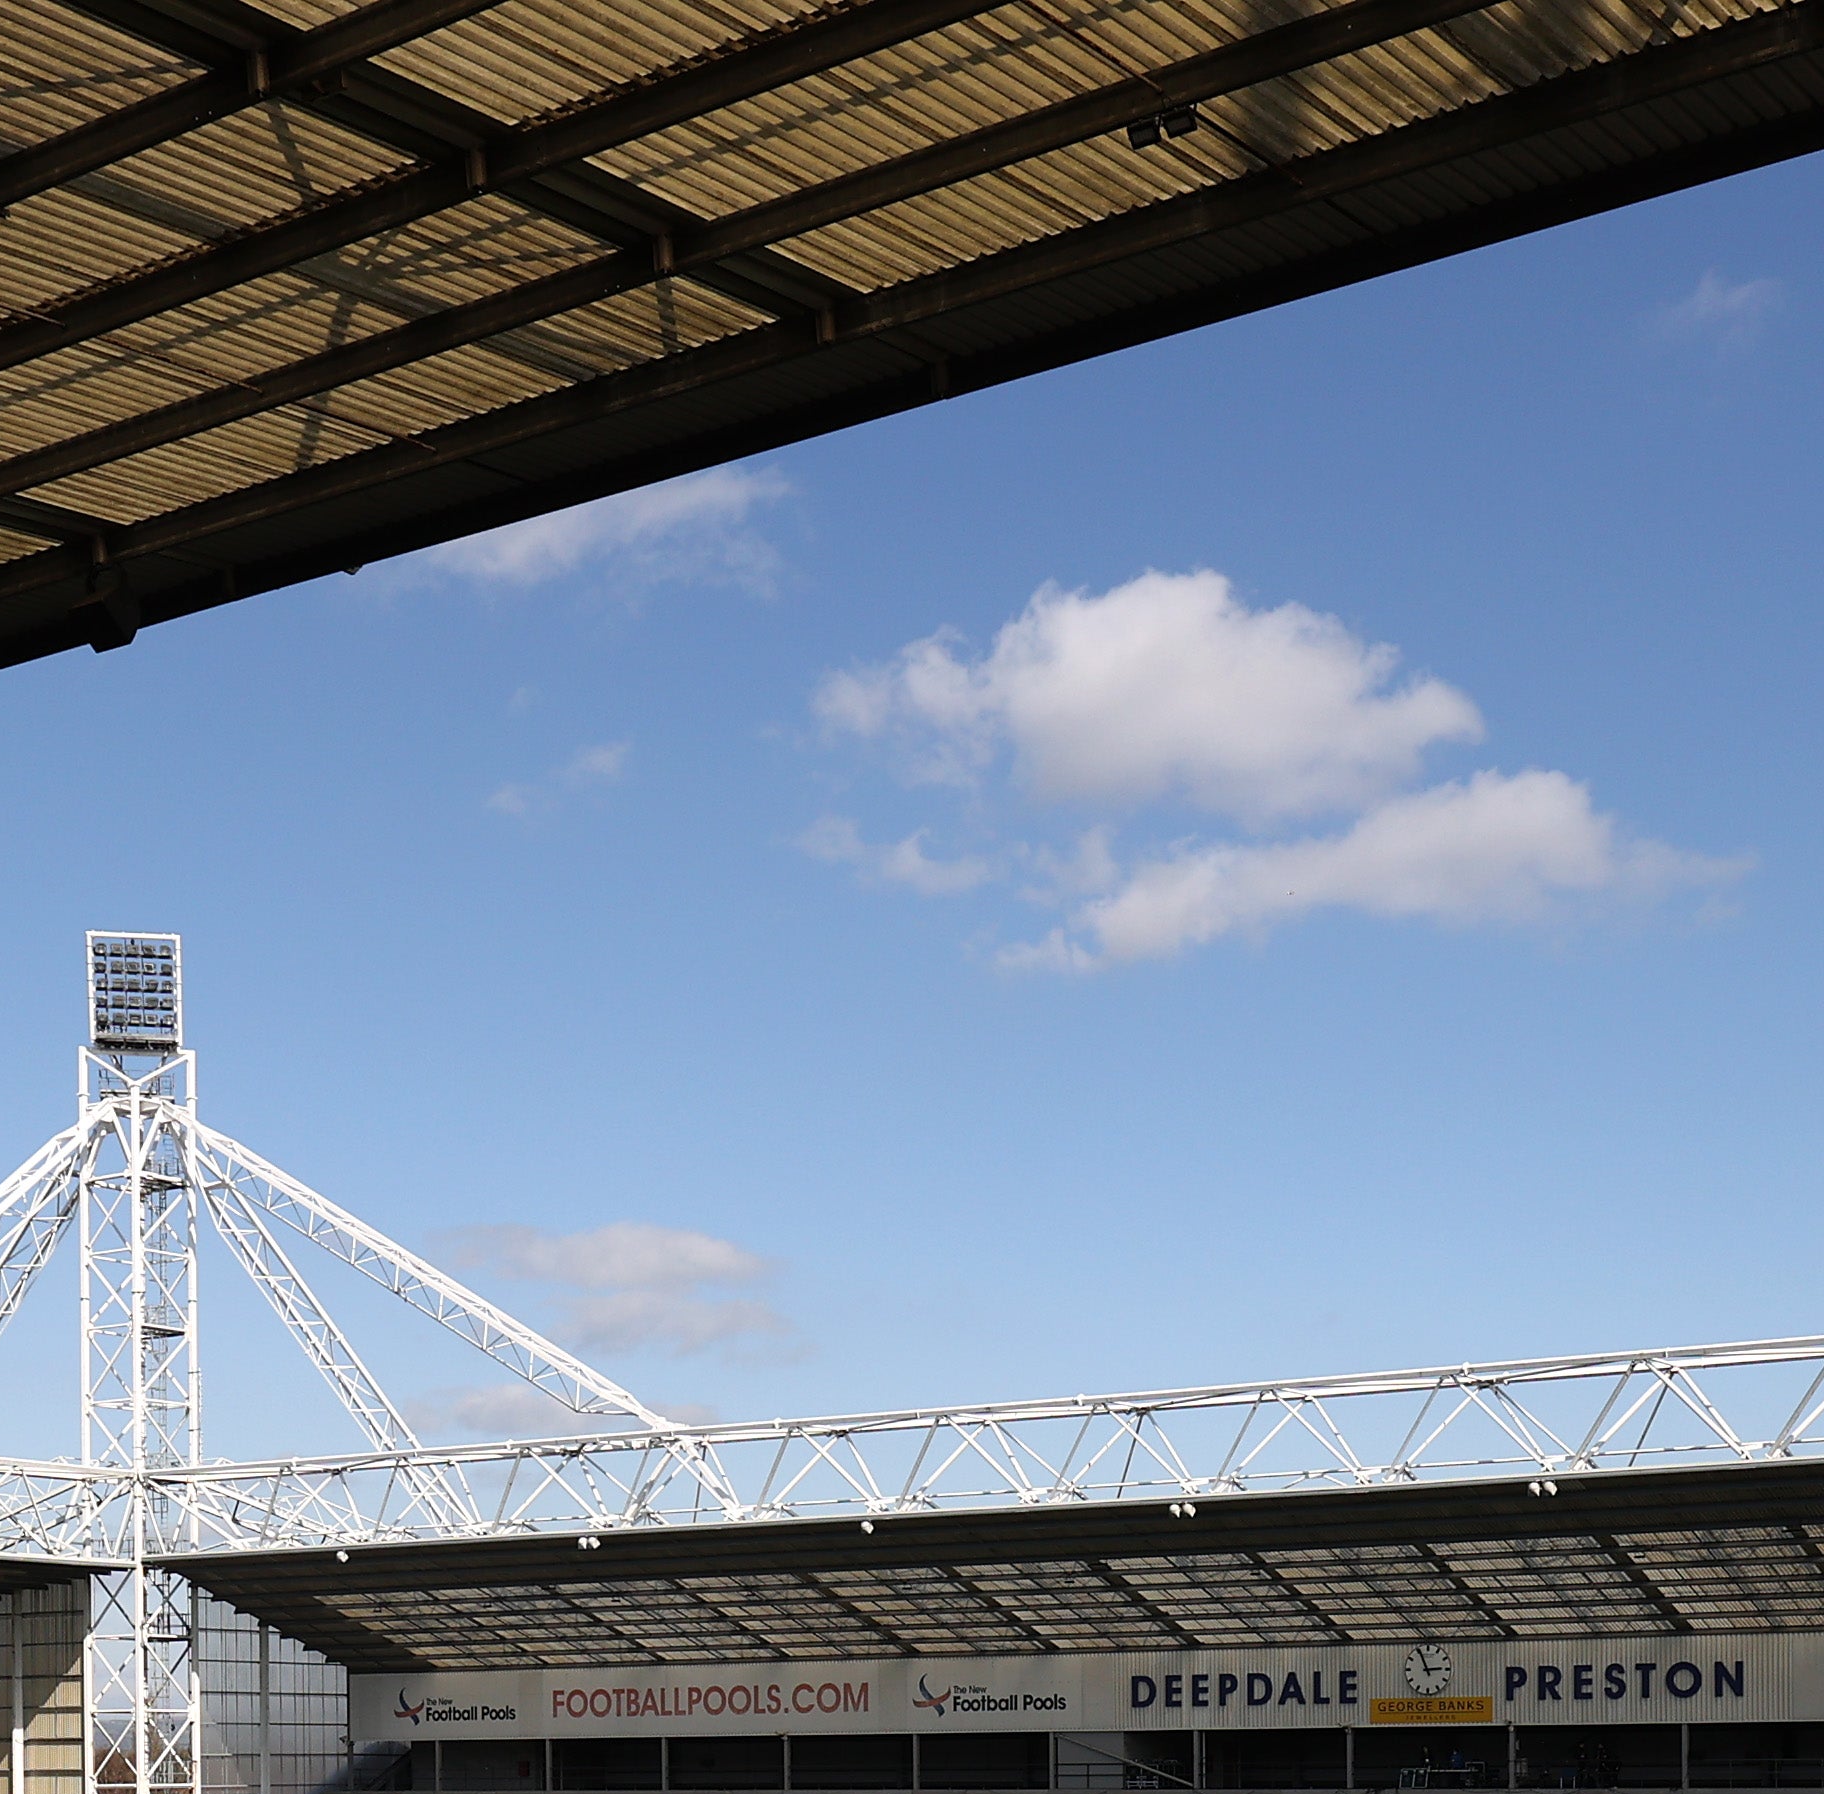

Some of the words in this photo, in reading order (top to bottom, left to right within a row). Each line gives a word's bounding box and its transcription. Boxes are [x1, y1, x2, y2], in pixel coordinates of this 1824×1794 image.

[953, 1685, 967, 1694] The
[969, 1685, 987, 1694] New
[1131, 1670, 1358, 1707] DEEPDALE
[1506, 1661, 1745, 1702] PRESTON
[553, 1682, 869, 1717] FOOTBALLPOOLS.COM
[953, 1695, 1017, 1712] Football
[1023, 1693, 1066, 1711] Pools
[1377, 1701, 1430, 1711] GEORGE
[1435, 1701, 1485, 1712] BANKS
[426, 1706, 478, 1722] Football
[481, 1705, 516, 1721] Pools
